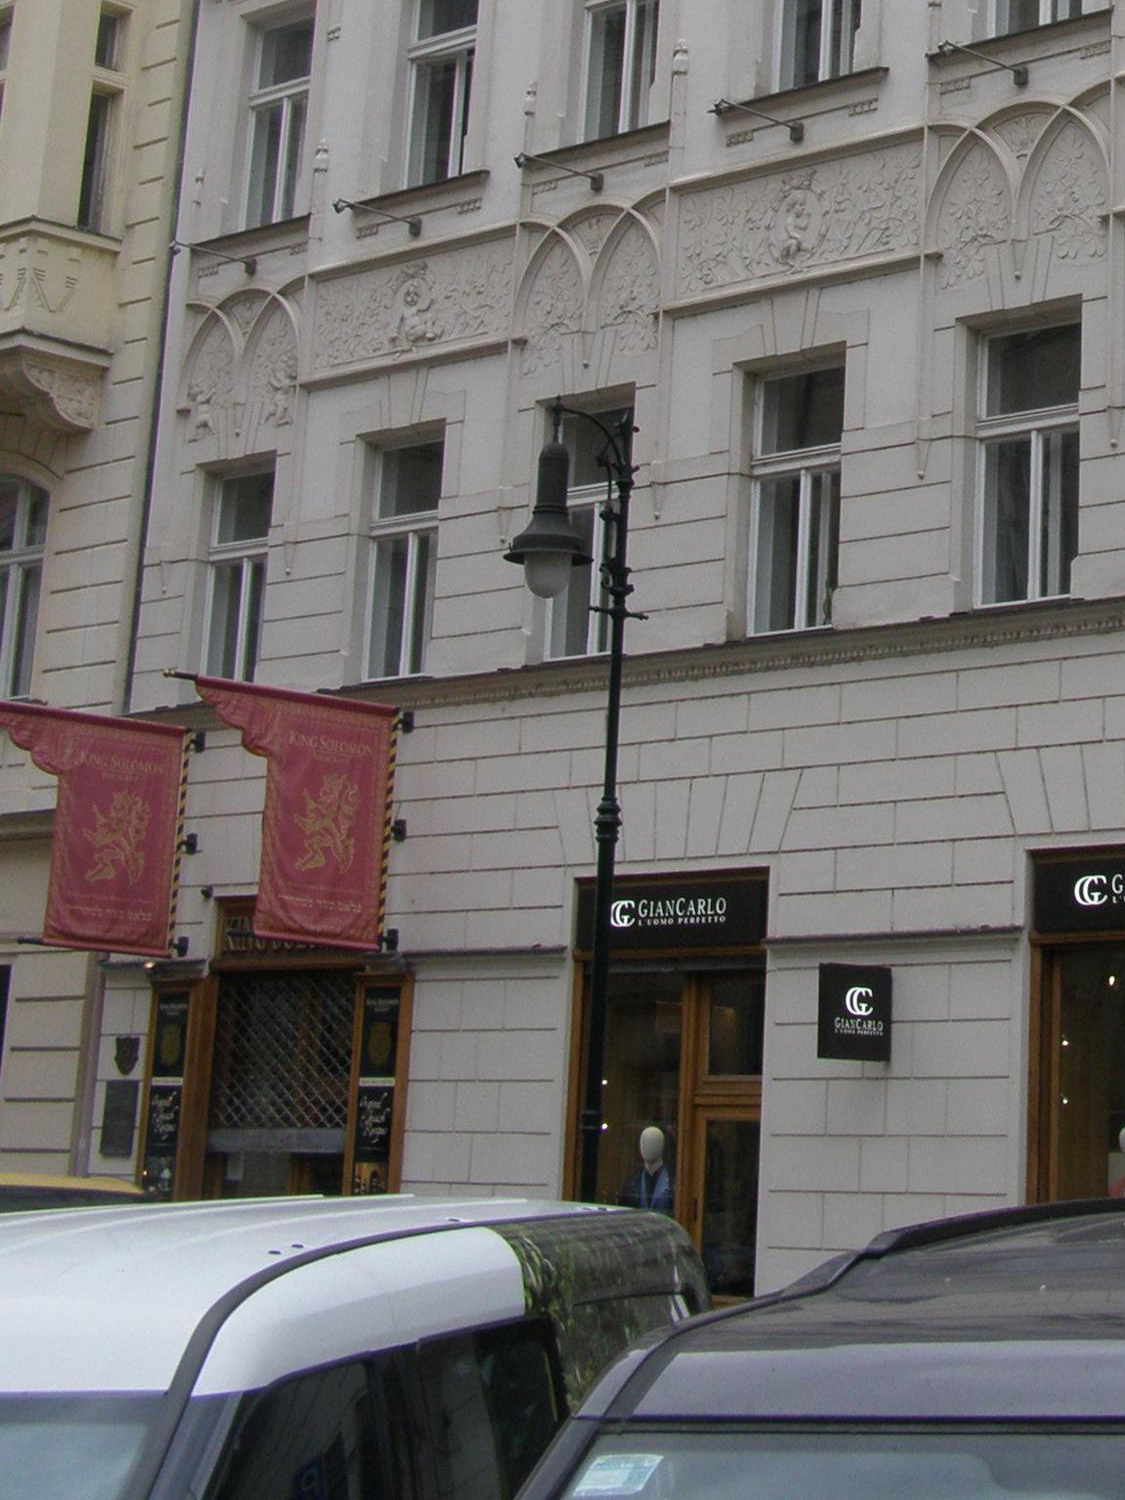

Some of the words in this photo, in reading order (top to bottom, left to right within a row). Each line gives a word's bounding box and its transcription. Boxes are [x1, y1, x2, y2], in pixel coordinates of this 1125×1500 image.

[638, 897, 727, 918] GIANCARLO
[677, 915, 727, 925] PERFETTO
[834, 1016, 884, 1032] GIANCARLO
